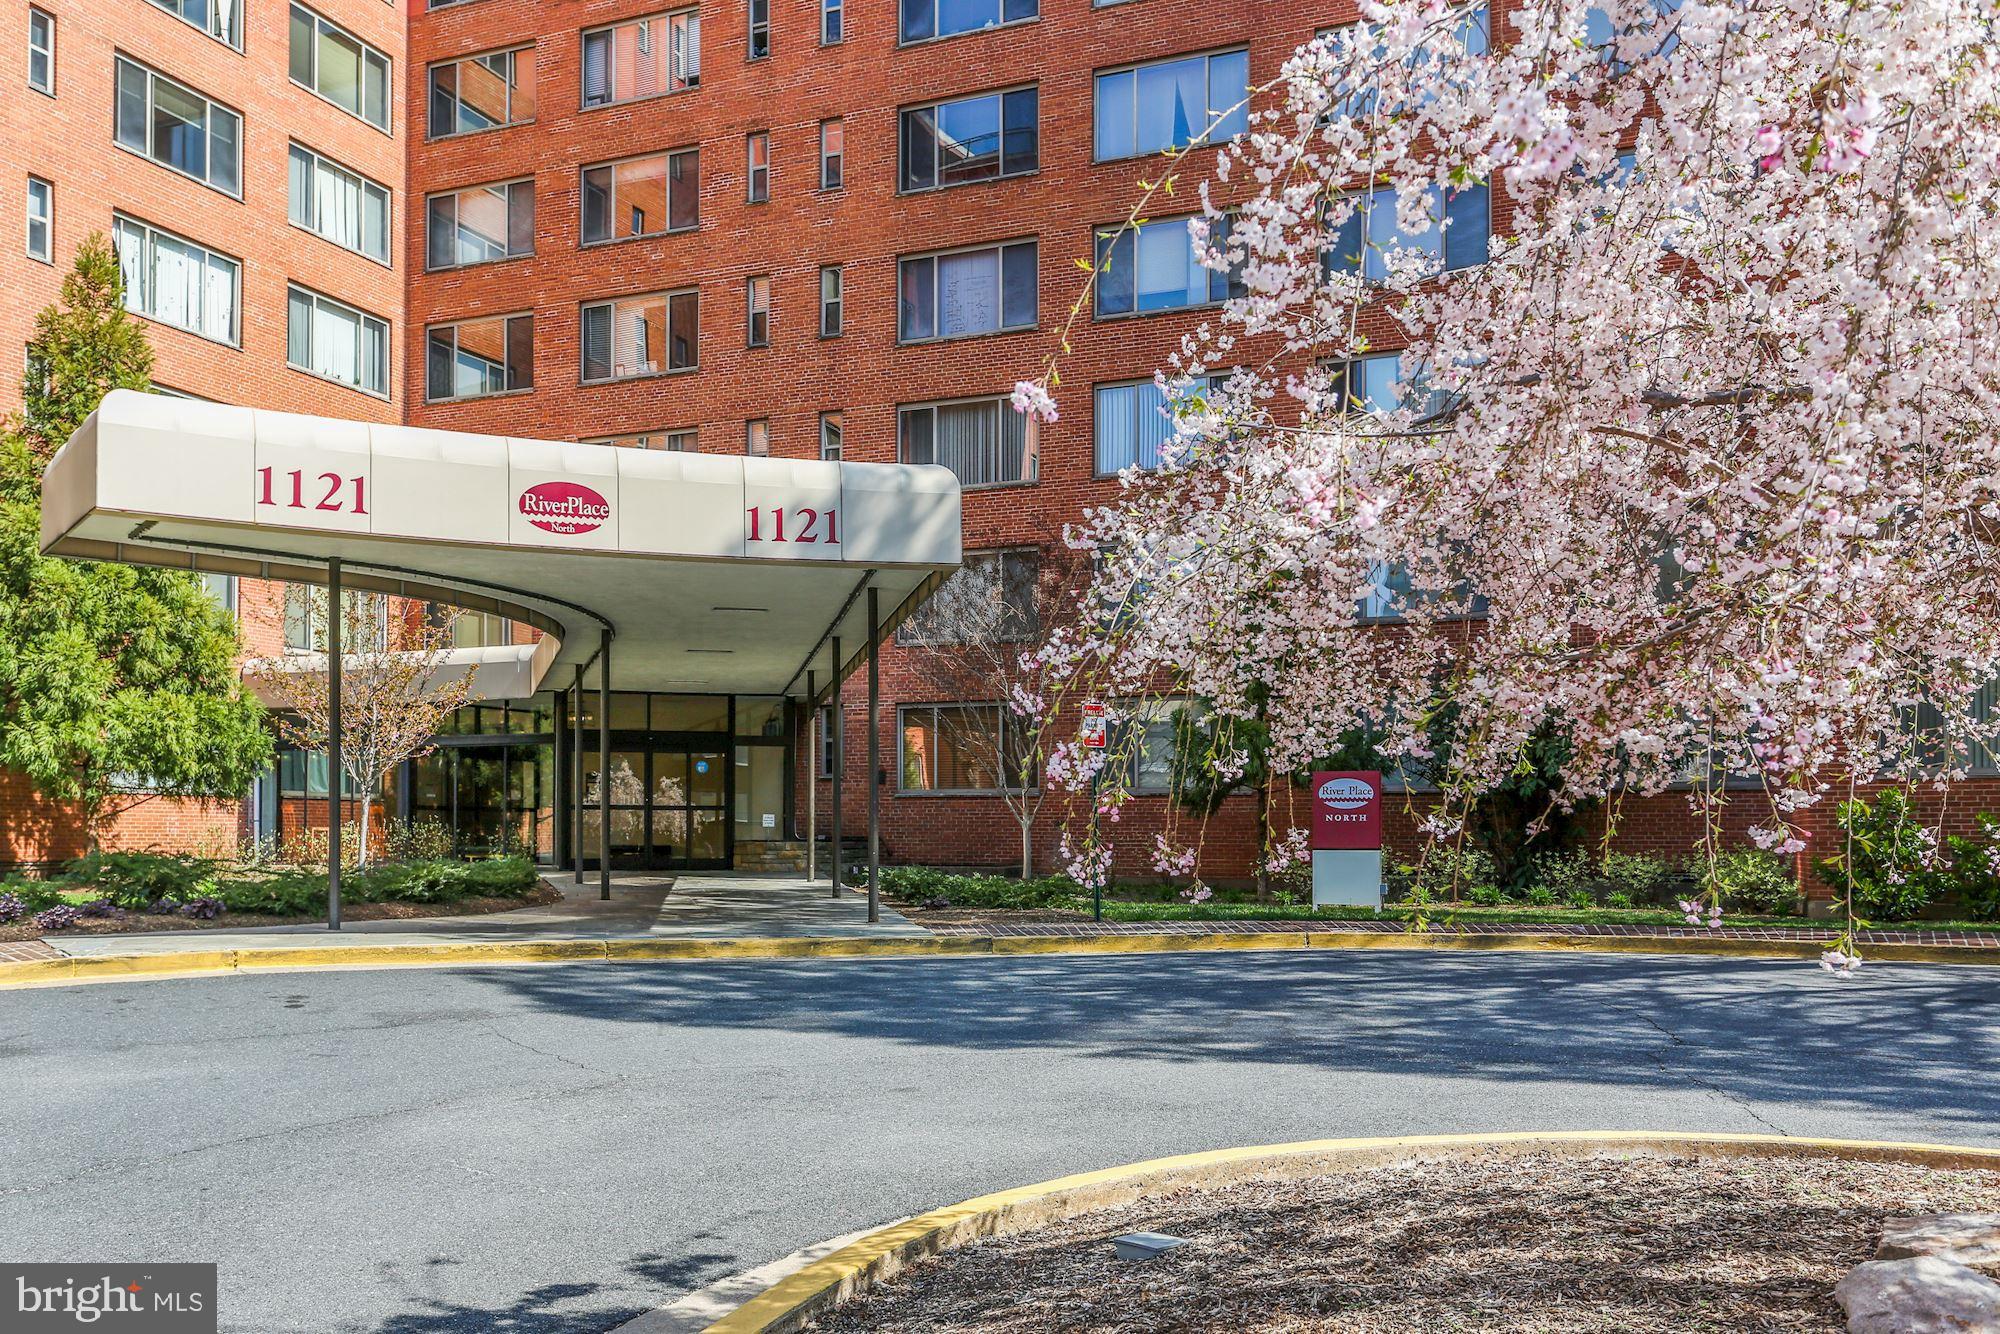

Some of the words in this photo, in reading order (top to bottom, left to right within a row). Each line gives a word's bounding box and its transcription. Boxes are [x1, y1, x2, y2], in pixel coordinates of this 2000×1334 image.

[257, 466, 369, 515] 1121
[523, 493, 609, 516] RiverPlace
[551, 523, 576, 534] North
[746, 506, 840, 544] 1121
[1322, 786, 1345, 796] River
[1349, 785, 1373, 795] Place
[1325, 814, 1367, 822] NORTH
